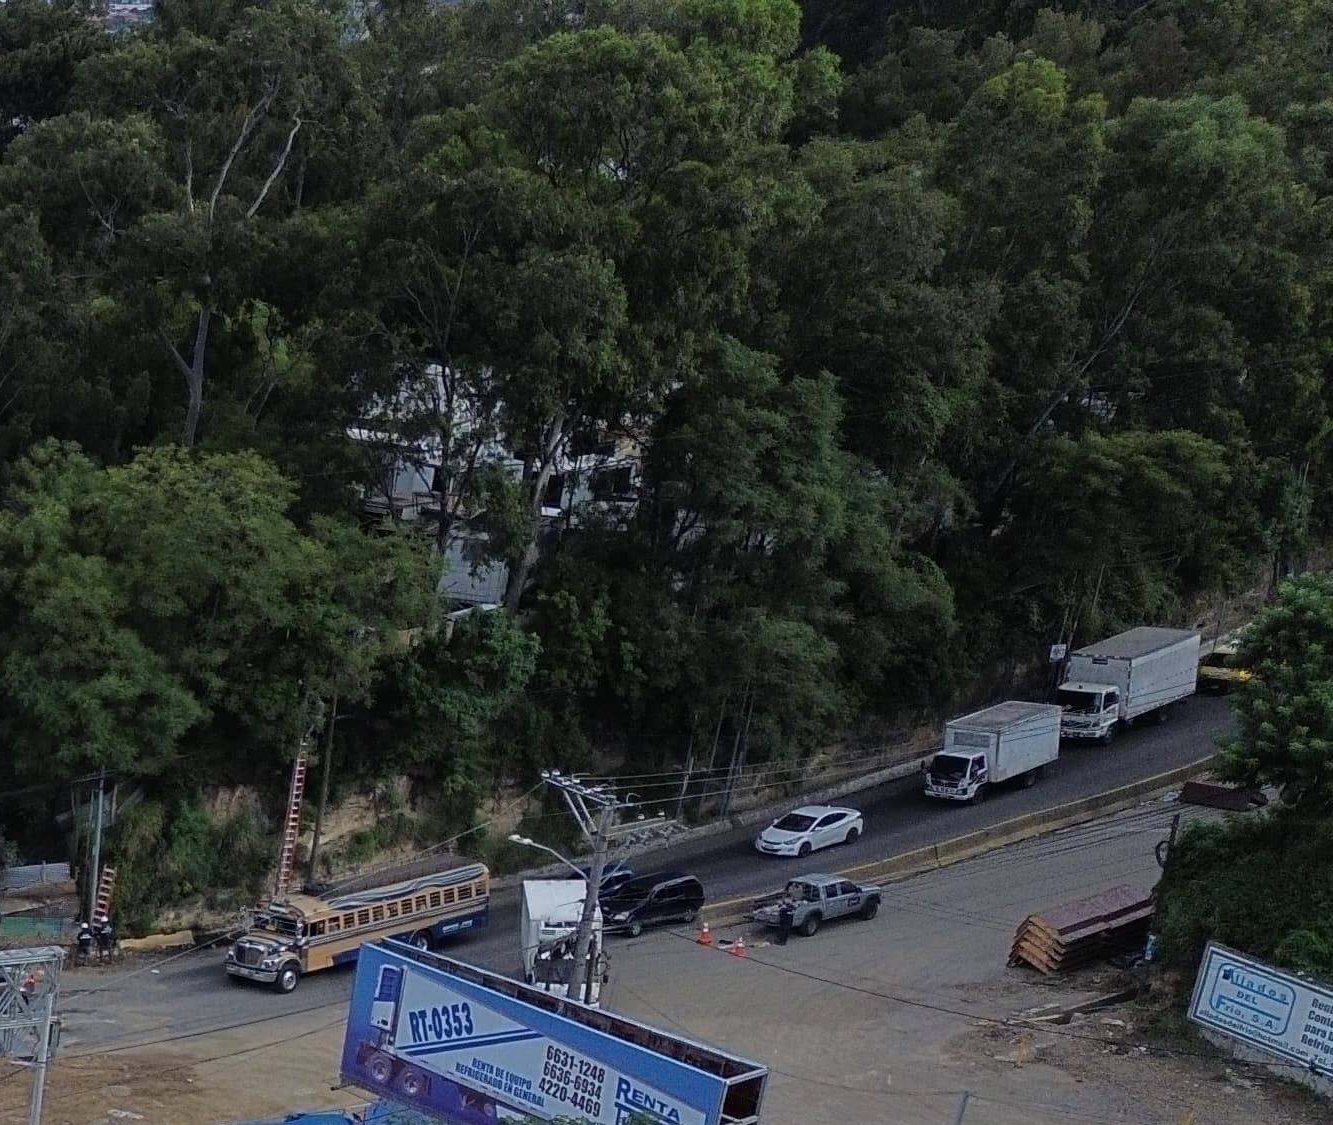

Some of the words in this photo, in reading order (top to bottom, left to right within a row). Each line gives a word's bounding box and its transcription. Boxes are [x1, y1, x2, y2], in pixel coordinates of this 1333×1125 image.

[1236, 990, 1258, 1005] DEL
[409, 1002, 473, 1043] RT-0353
[1304, 1024, 1327, 1039] para
[1300, 1034, 1333, 1055] Refrig
[471, 1057, 494, 1075] RENTA
[495, 1066, 505, 1080] DE
[506, 1071, 532, 1091] EQUIPO
[543, 1061, 602, 1101] 6636-6934
[546, 1045, 606, 1084] 6631-1248
[455, 1061, 503, 1090] REFRIGERADO
[503, 1081, 513, 1094] EN
[513, 1086, 545, 1108] GENERAL
[538, 1077, 601, 1117] 4220-4469
[615, 1076, 680, 1122] RENTA
